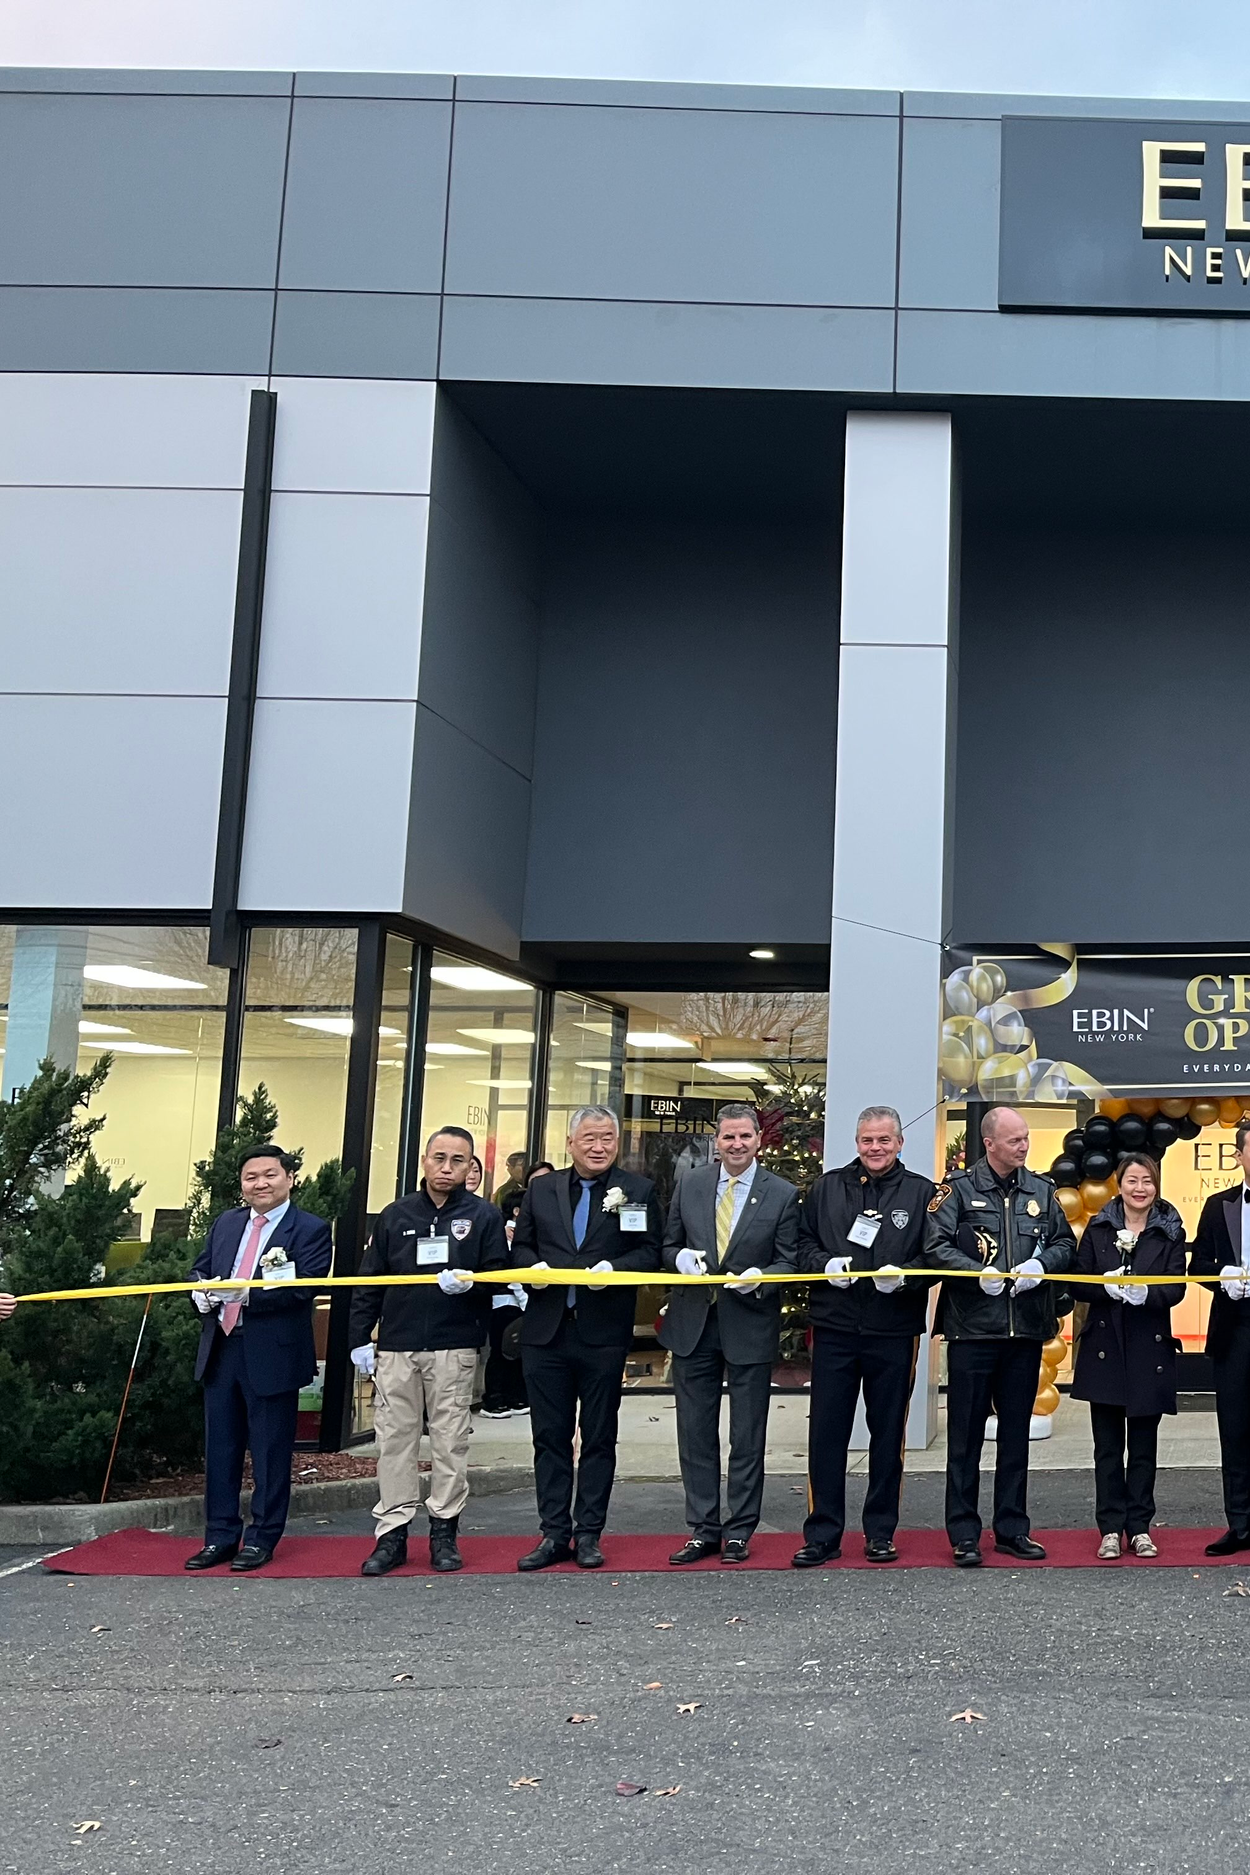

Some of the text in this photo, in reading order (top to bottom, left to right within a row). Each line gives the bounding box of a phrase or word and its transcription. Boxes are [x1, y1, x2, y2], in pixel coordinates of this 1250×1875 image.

[1078, 1033, 1143, 1042] NEW YORK
[650, 1099, 682, 1112] EBIN
